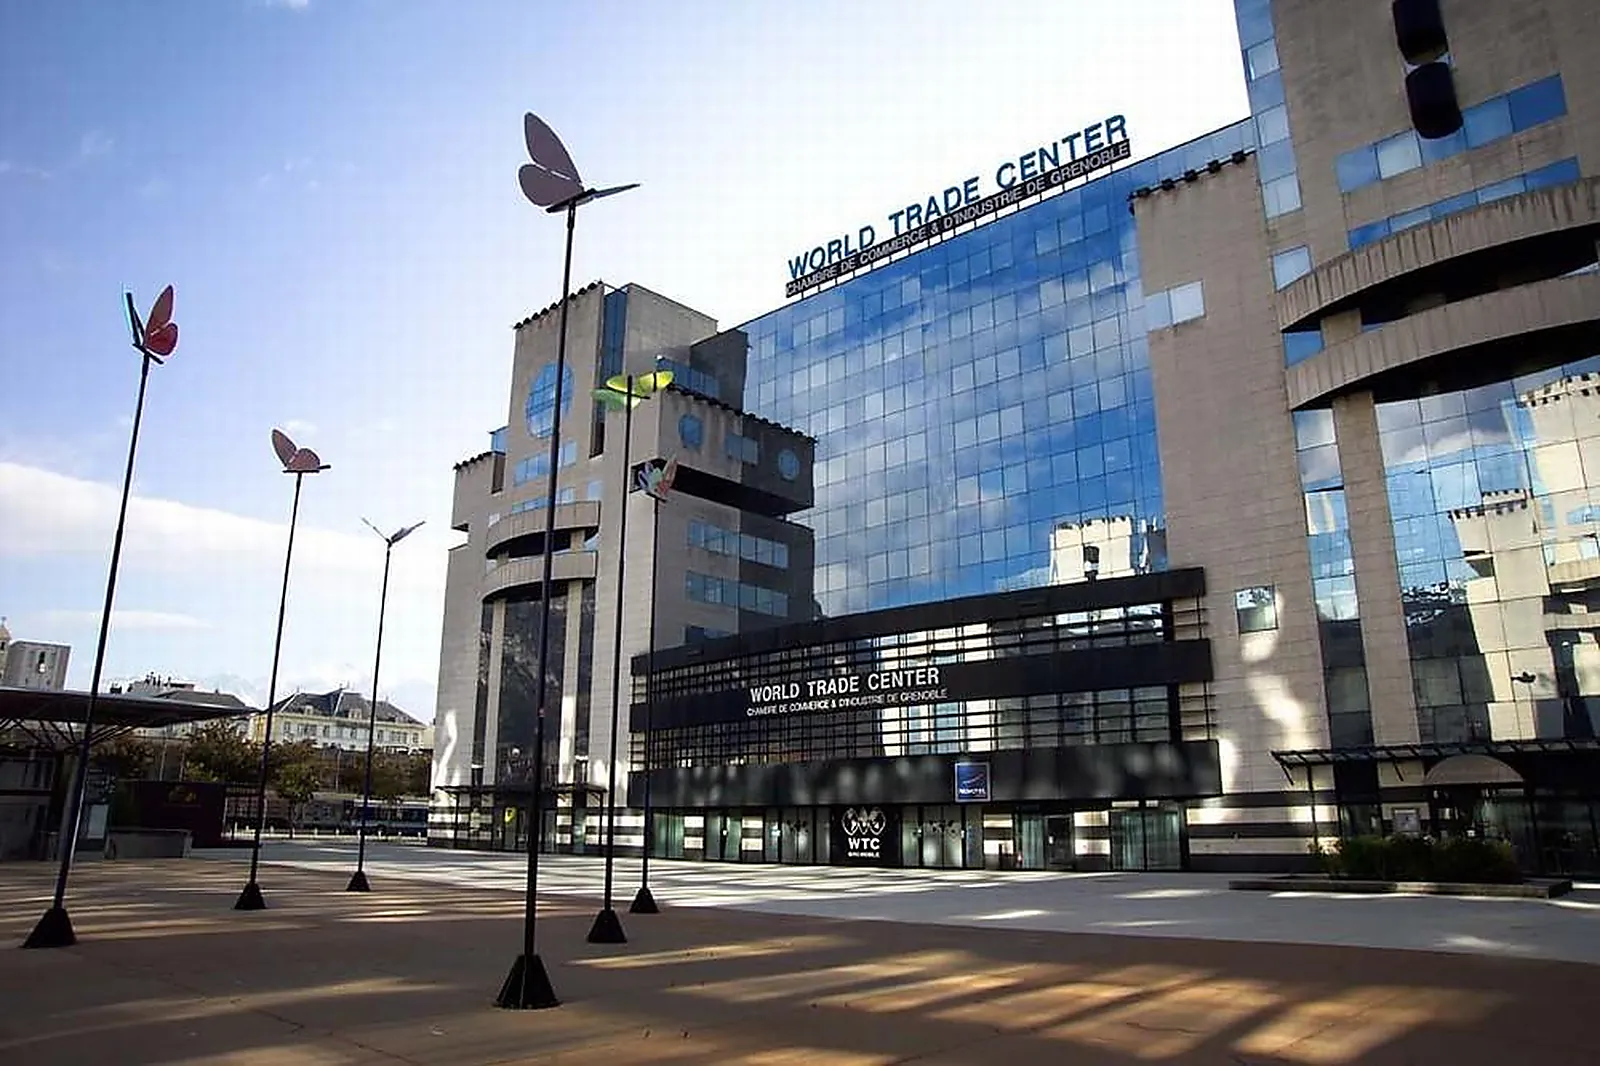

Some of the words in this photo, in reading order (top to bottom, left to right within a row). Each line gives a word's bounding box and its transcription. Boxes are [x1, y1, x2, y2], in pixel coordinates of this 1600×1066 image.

[786, 265, 838, 296] CHAMBRE
[840, 257, 857, 275] DE
[860, 228, 927, 266] COMMERCE
[930, 222, 940, 234] &
[943, 186, 1023, 230] D'INDUSTRIE
[1026, 177, 1046, 194] DE
[1050, 141, 1130, 185] GRENOBLE
[788, 224, 876, 279] WORLD
[888, 175, 981, 235] TRADE
[996, 113, 1128, 190] CENTER
[750, 683, 800, 703] WORLD
[807, 675, 860, 697] TRADE
[868, 667, 940, 691] CENTER
[848, 838, 880, 850] WTC
